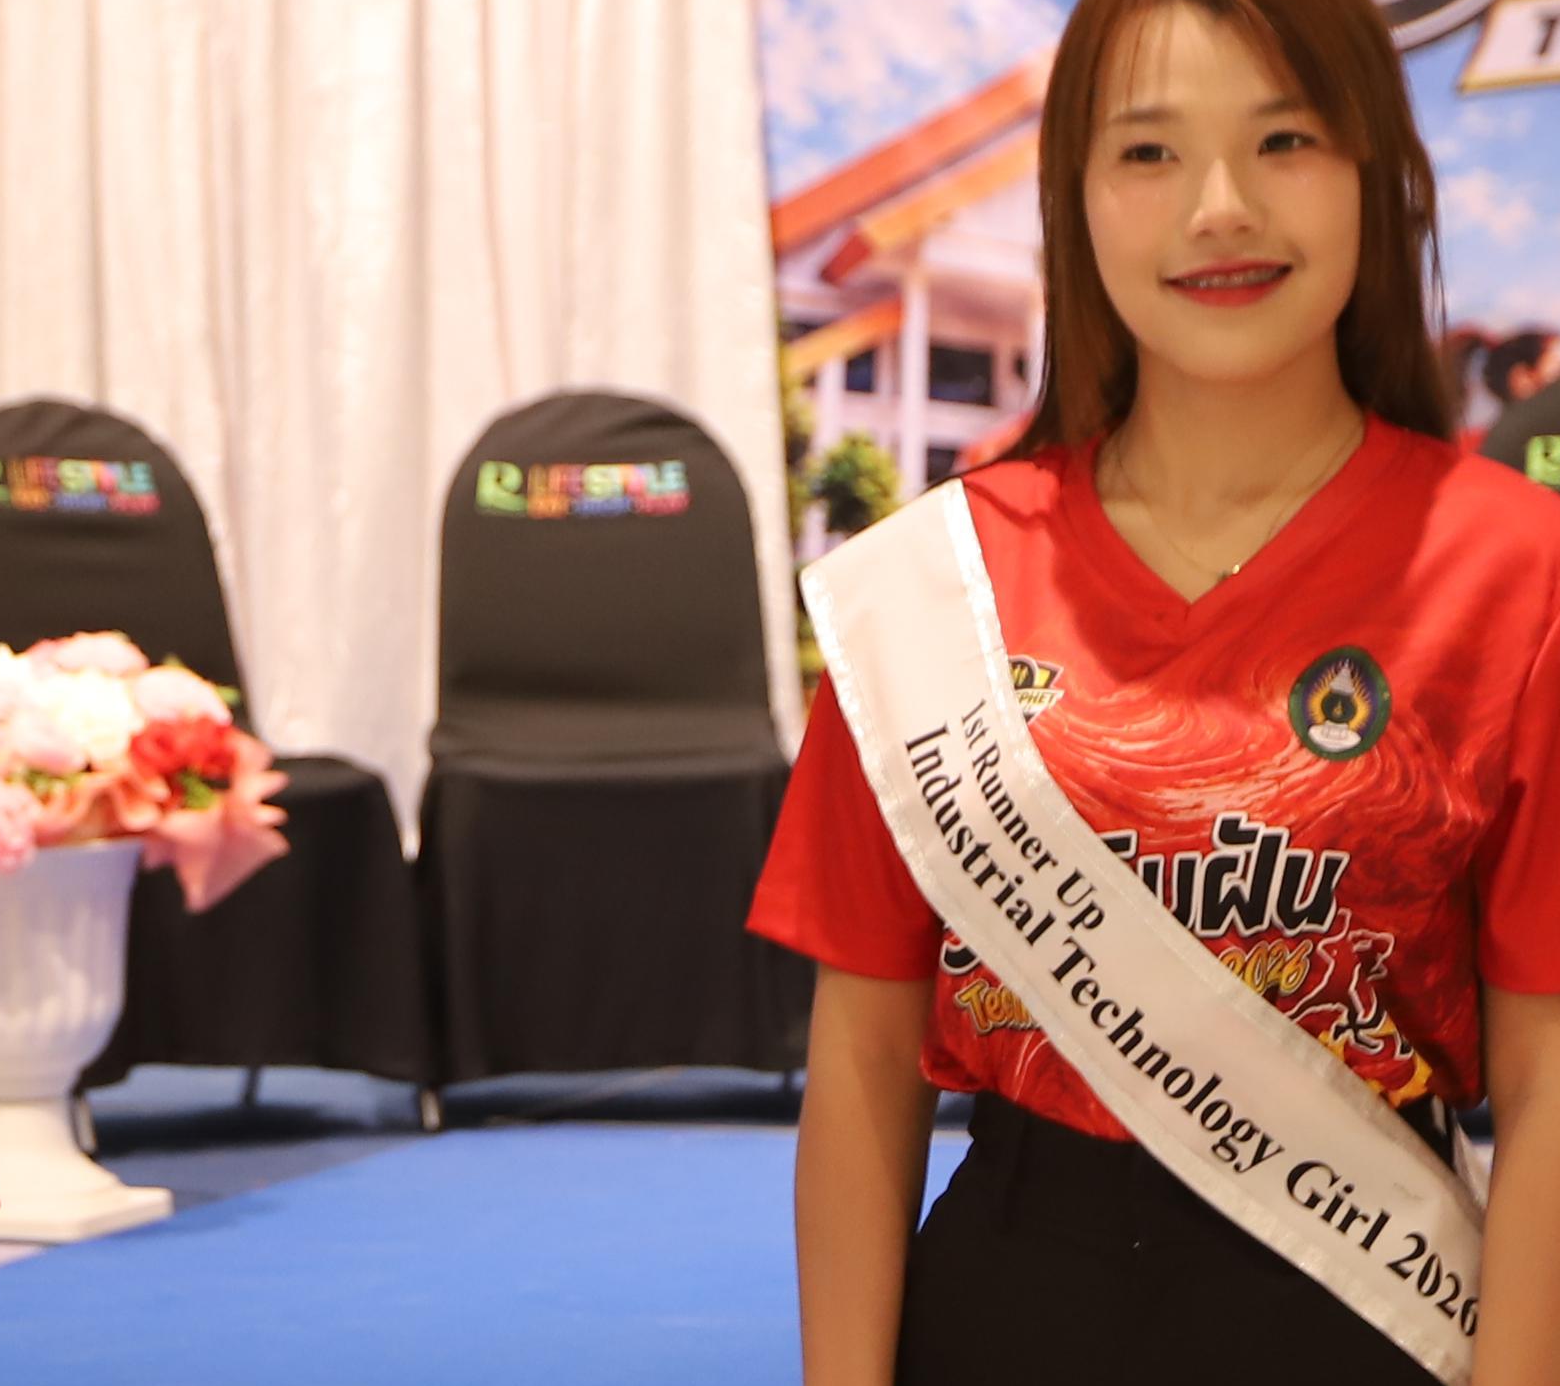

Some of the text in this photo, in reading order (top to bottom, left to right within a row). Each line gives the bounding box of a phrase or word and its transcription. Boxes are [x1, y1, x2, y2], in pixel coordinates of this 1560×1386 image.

[961, 698, 994, 750] 1st
[972, 740, 1058, 873] Runner
[1056, 867, 1105, 933] Up
[905, 720, 1479, 1337] Industrial Technology Girl 2026
